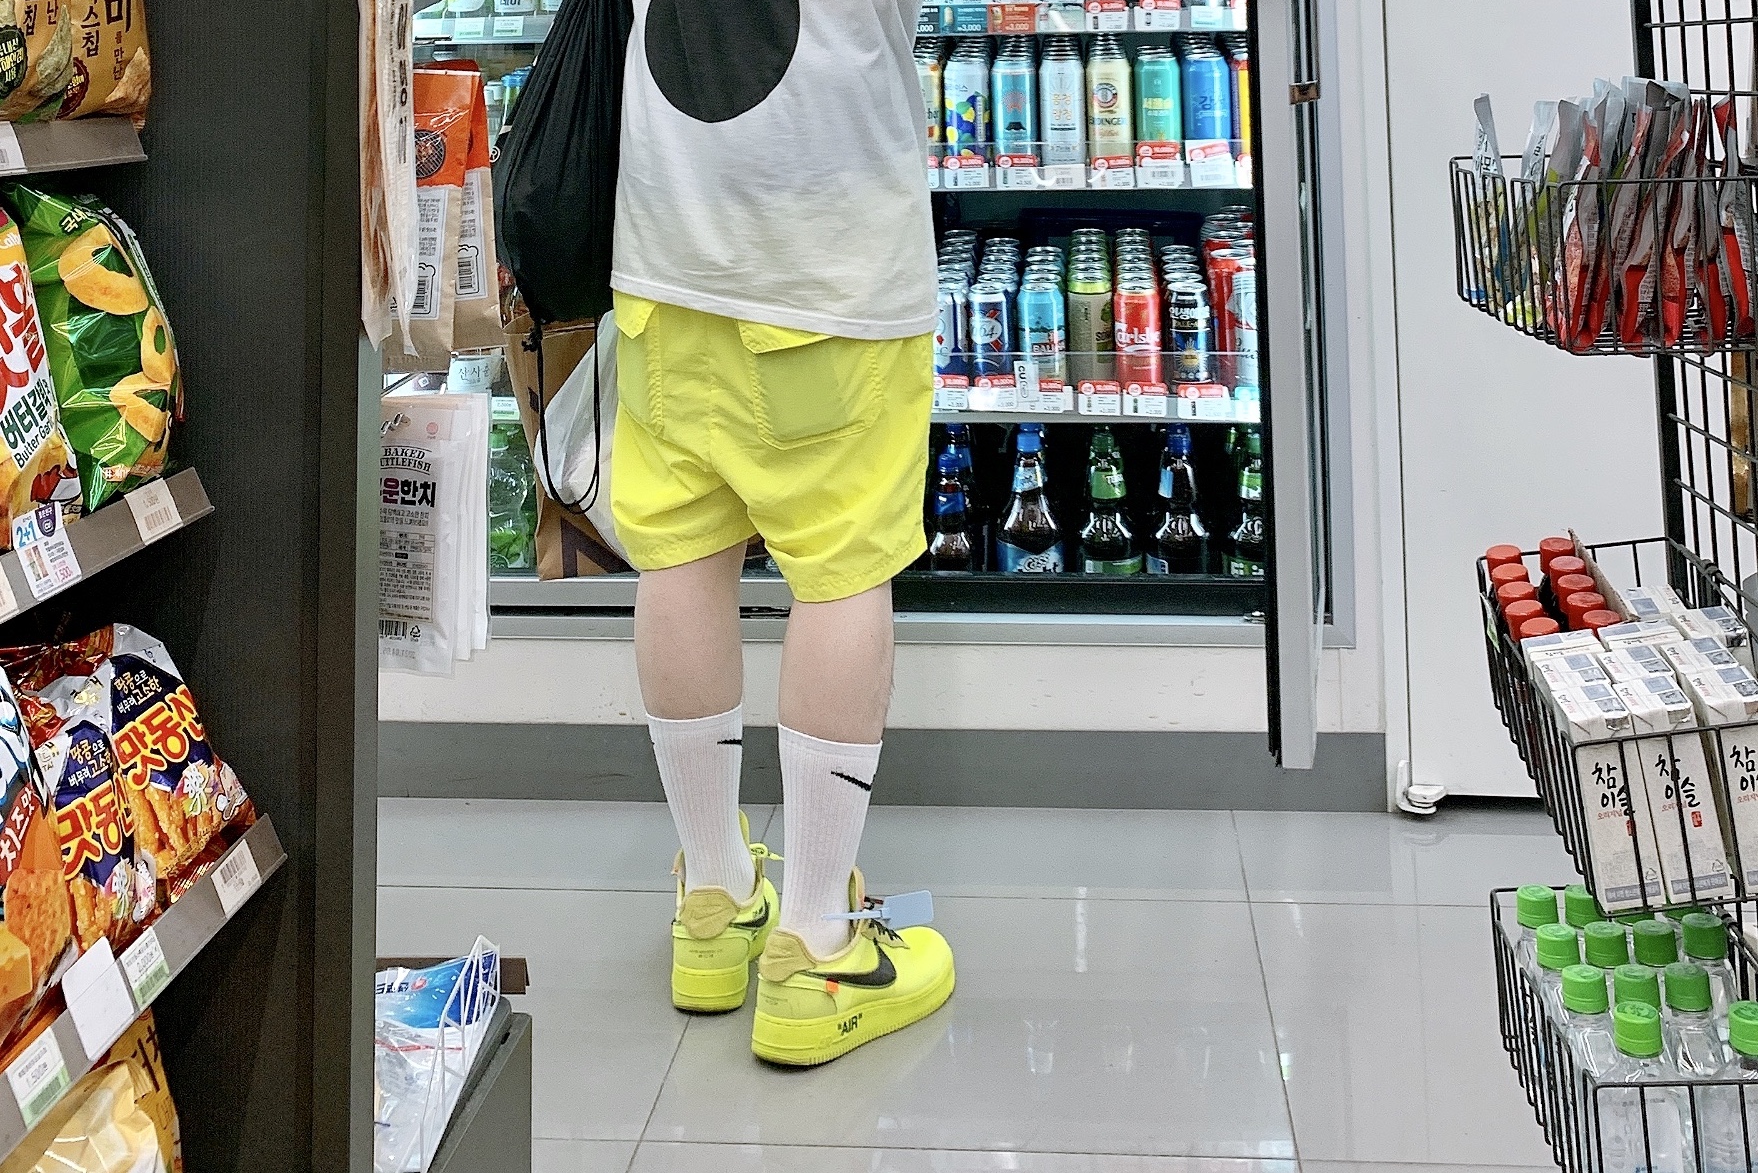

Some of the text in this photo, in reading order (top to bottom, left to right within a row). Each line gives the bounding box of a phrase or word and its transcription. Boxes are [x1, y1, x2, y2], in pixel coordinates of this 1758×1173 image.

[14, 435, 40, 470] Butter
[380, 457, 432, 472] UTTLEFISH
[383, 447, 425, 460] BAKED
[380, 477, 436, 508] 운한치
[16, 520, 38, 548] 2+1
[114, 669, 149, 694] 땅콩으로
[117, 675, 163, 714] 버무려 고소한
[70, 739, 106, 766] 땅콩으로
[67, 768, 91, 788] 버무려
